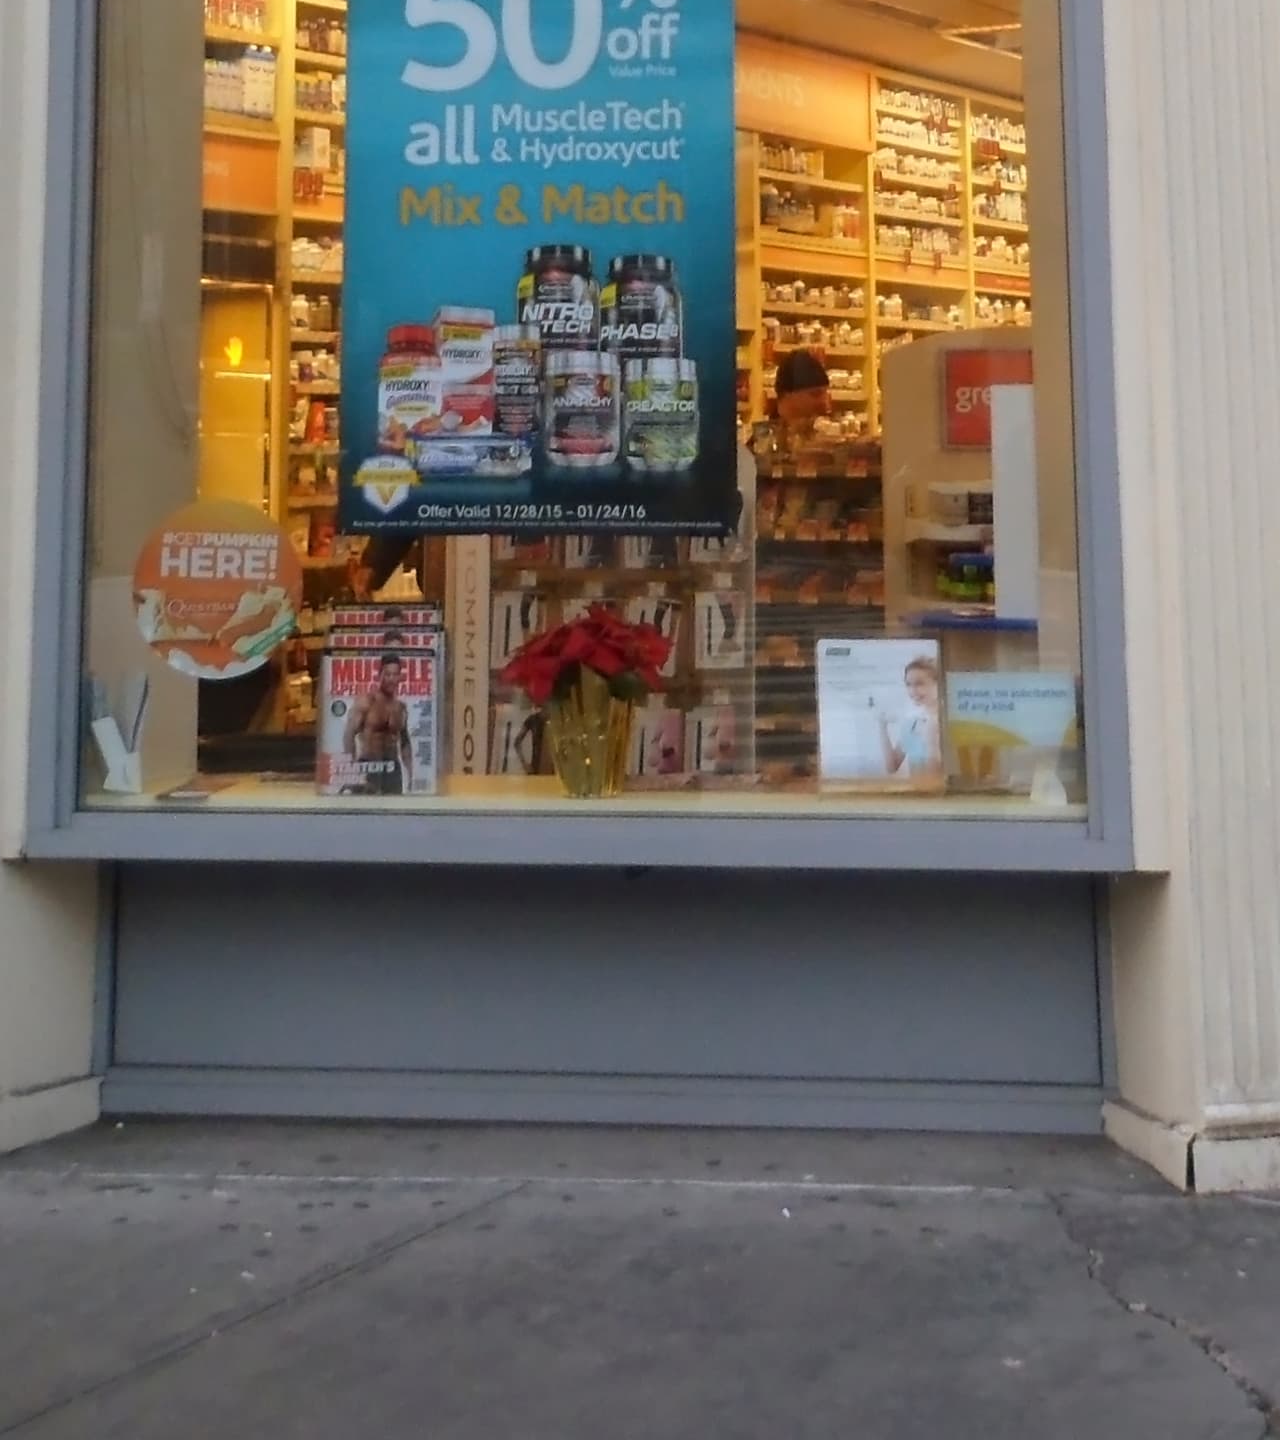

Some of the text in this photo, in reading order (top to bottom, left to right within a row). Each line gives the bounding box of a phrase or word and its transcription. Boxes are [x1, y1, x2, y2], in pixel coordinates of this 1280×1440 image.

[606, 13, 680, 61] off
[491, 100, 682, 133] MuscleTech
[404, 105, 480, 165] all
[491, 136, 682, 168] & Hydroxycut
[400, 180, 685, 226] Mix & Match
[521, 303, 594, 322] NITRO
[540, 320, 592, 334] TECH
[418, 504, 452, 518] Offer
[455, 504, 491, 518] Valid
[495, 504, 562, 519] 12/28/15
[577, 504, 646, 519] 01/24/16
[160, 546, 278, 580] HERE!
